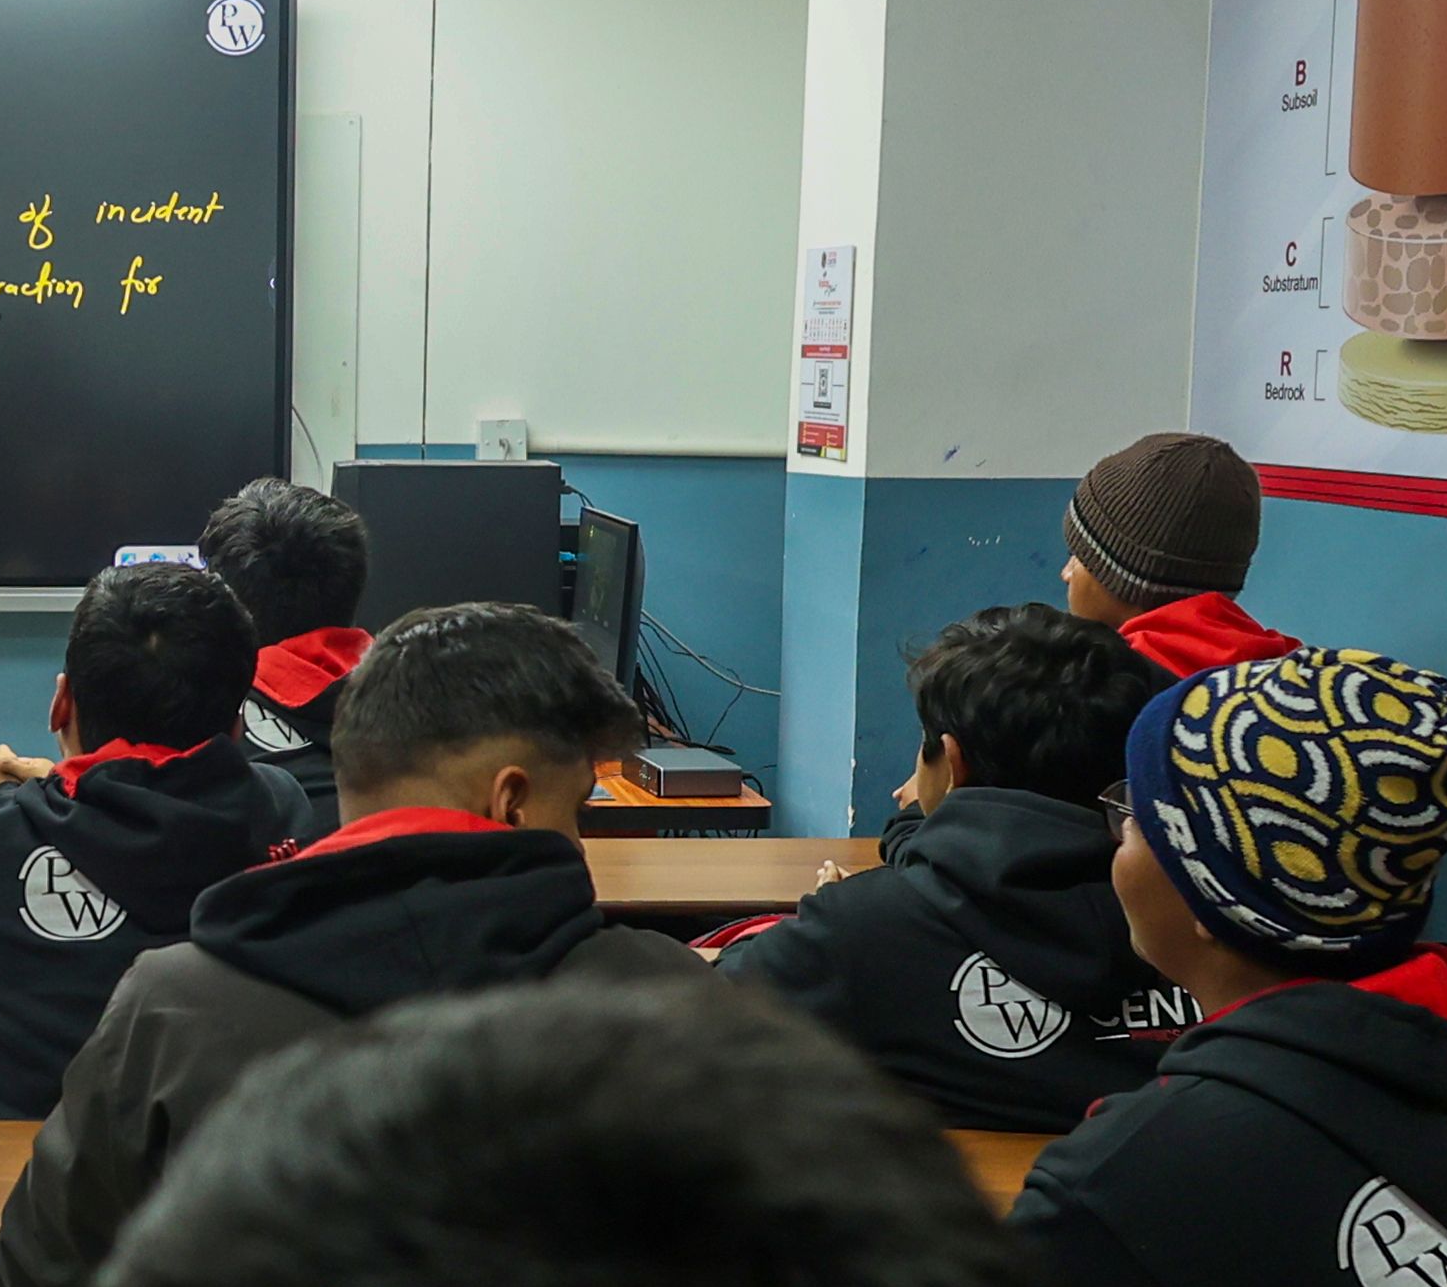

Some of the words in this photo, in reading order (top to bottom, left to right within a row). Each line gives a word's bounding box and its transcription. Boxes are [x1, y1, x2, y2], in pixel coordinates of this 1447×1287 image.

[1295, 60, 1306, 86] B
[1282, 88, 1318, 113] Subsoil
[19, 195, 53, 250] of
[96, 192, 224, 225] incident
[1285, 241, 1297, 267] C
[121, 256, 162, 314] for
[1263, 273, 1319, 293] Substratum
[1281, 351, 1292, 376] R
[1265, 382, 1305, 401] Bedrock
